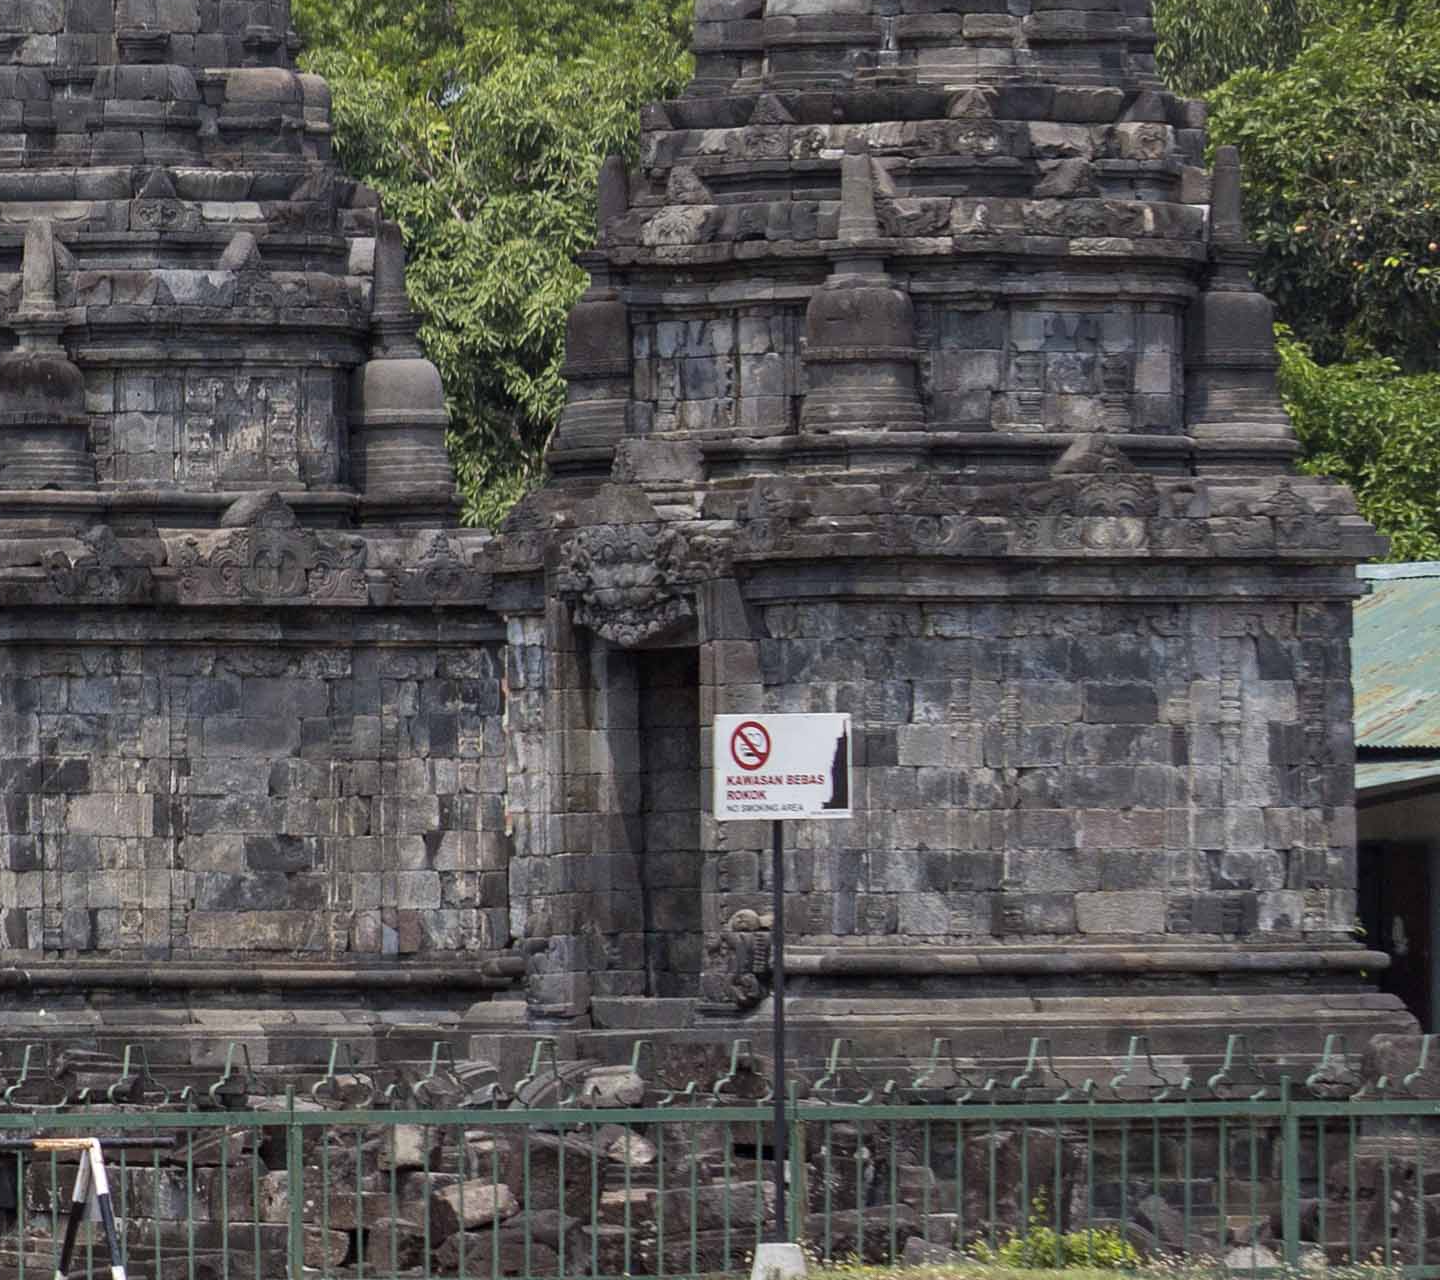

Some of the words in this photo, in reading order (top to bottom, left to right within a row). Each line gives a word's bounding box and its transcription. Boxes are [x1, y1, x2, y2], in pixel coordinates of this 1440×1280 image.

[727, 775, 783, 785] KAWASAN
[786, 774, 825, 785] BEBAS
[727, 790, 766, 800] ROKOK
[726, 804, 739, 812] NO
[741, 803, 779, 812] SMOKING
[781, 803, 805, 811] AREA
